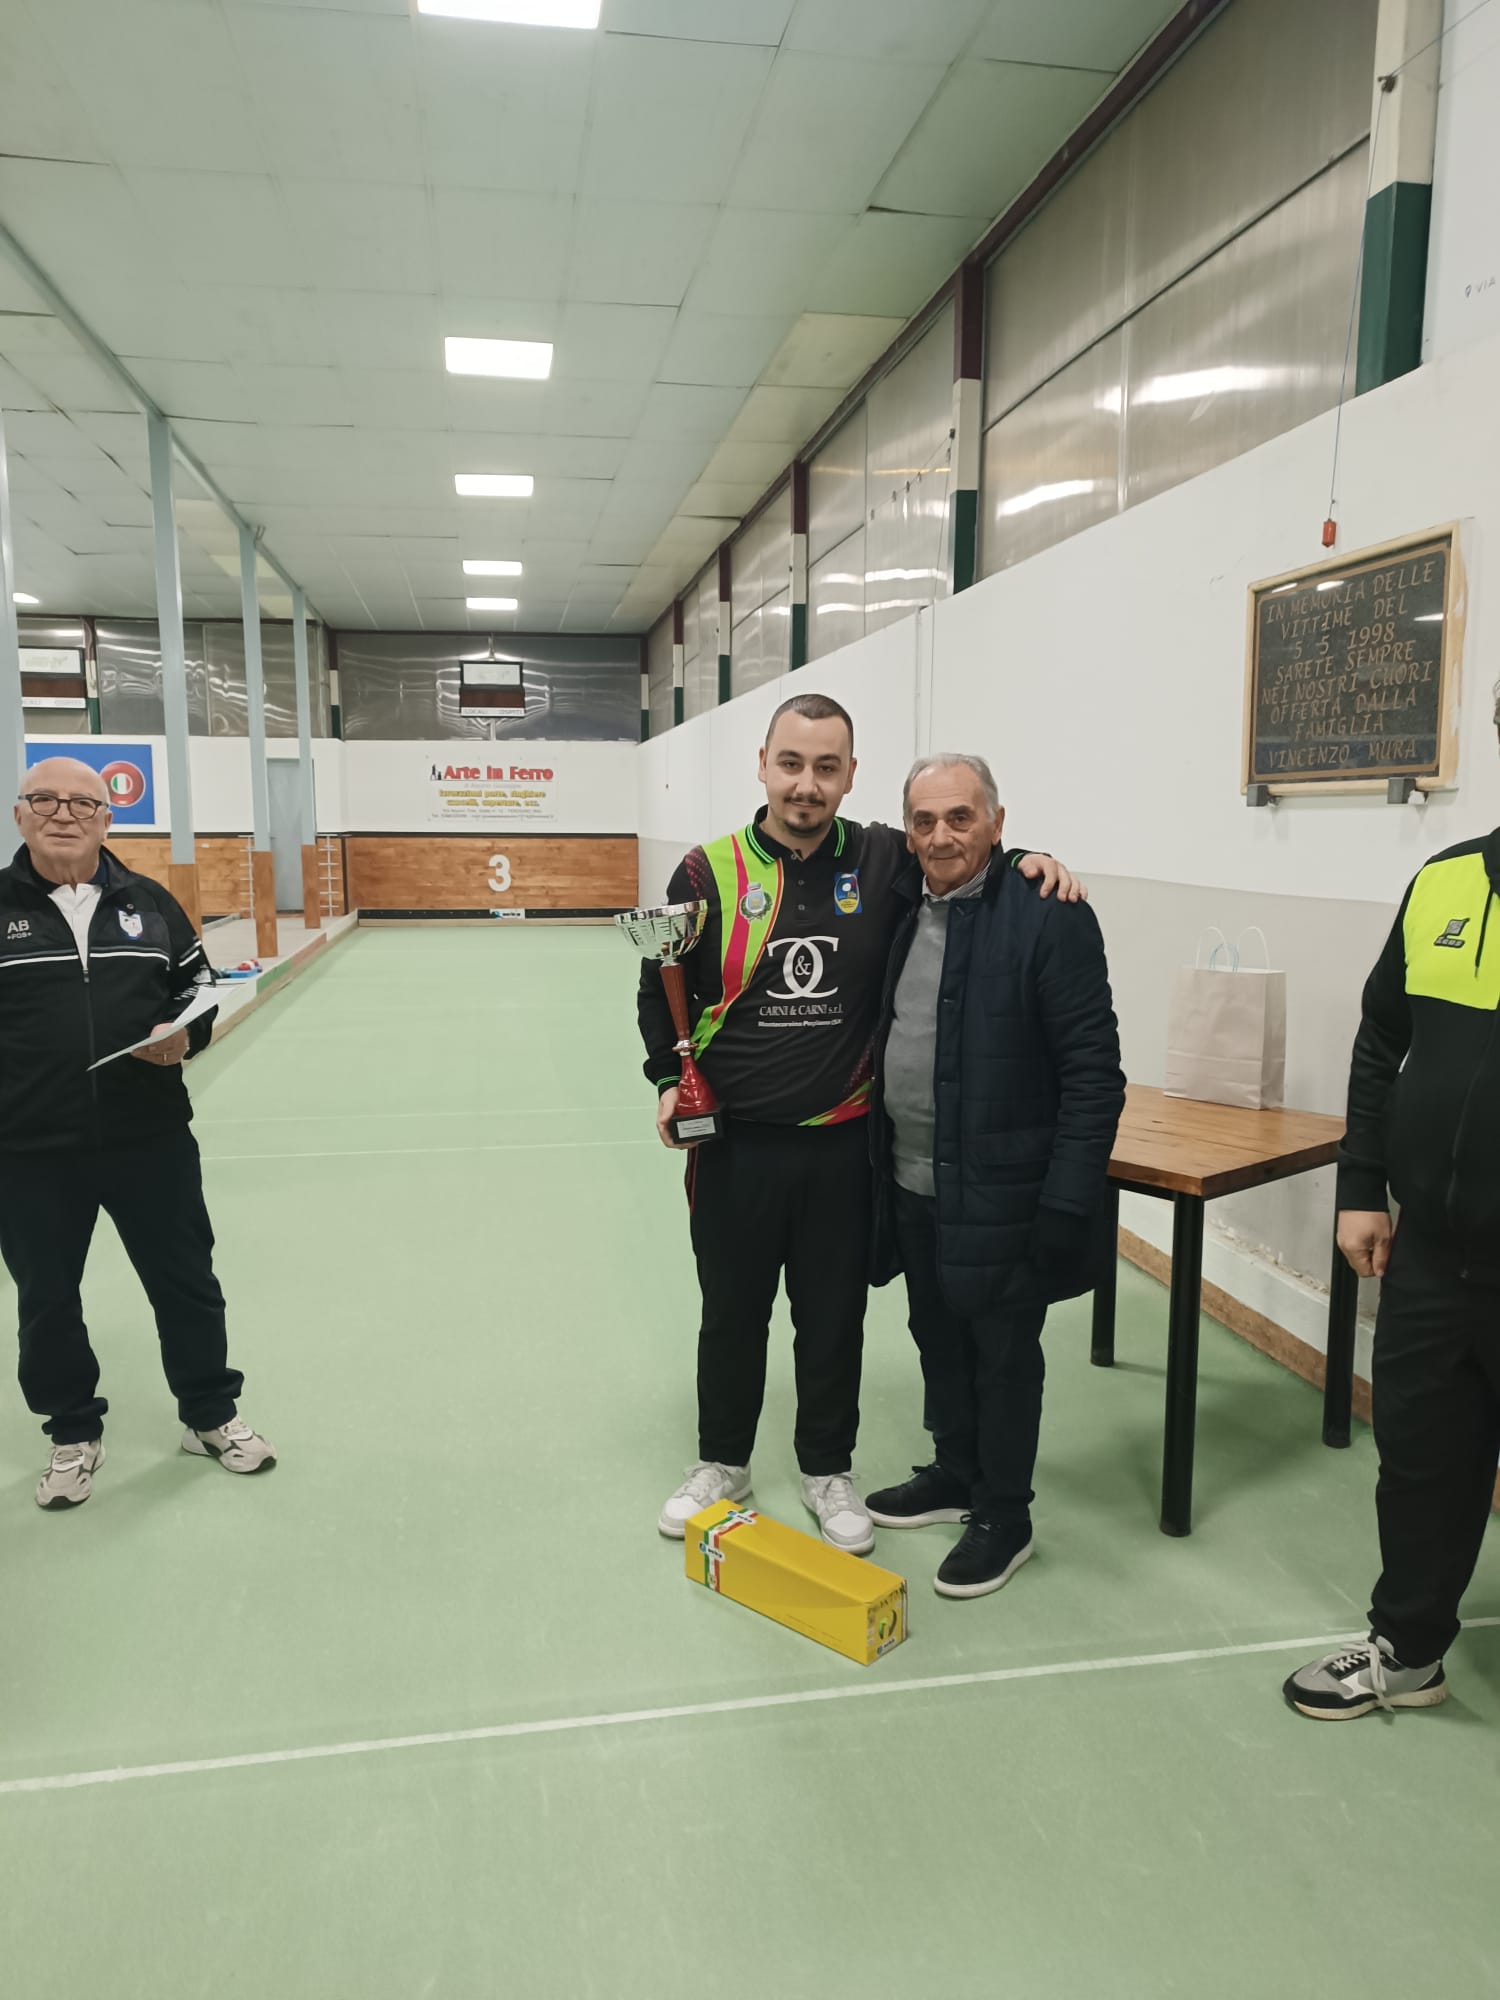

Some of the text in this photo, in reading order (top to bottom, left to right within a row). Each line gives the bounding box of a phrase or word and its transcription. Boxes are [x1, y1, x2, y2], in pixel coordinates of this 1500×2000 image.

[1266, 561, 1436, 624] IN MEMORIA DELLE
[1281, 593, 1408, 640] VITTIME DEL
[1347, 621, 1396, 650] 1998
[1275, 639, 1417, 686] SARETE SEMPRE
[1261, 685, 1290, 706] NEI
[1296, 672, 1360, 701] NOSTRI
[1270, 687, 1417, 725] OFFERTA DALLA
[1295, 712, 1384, 742] FAMIGLIA
[1268, 736, 1418, 769] VINCENZO MURA
[444, 765, 481, 780] Arte
[509, 766, 554, 781] Ferro
[488, 854, 512, 892] 3
[7, 919, 30, 934] AB
[759, 1006, 789, 1016] CARNI
[798, 1004, 828, 1015] CARNI
